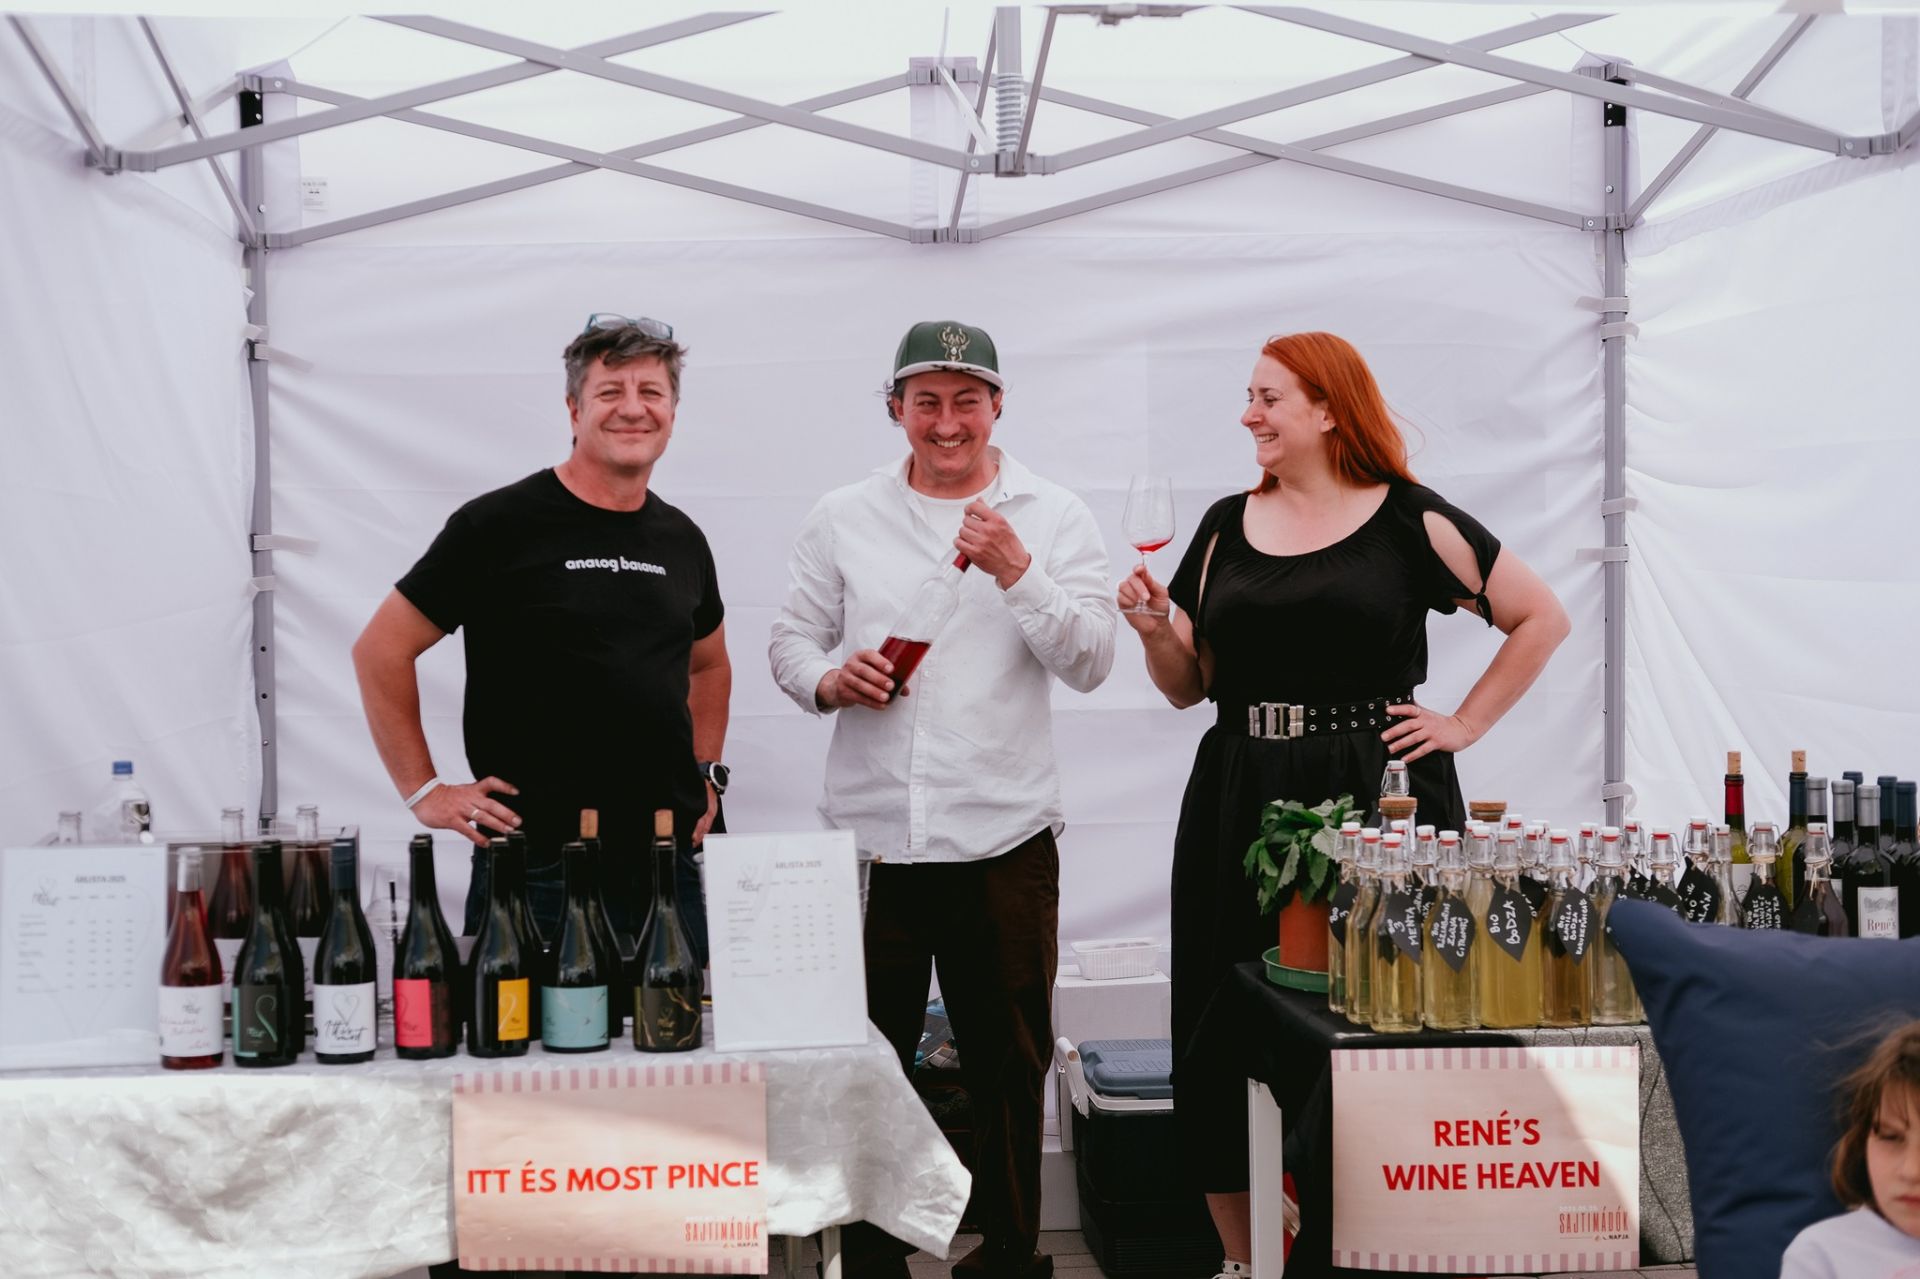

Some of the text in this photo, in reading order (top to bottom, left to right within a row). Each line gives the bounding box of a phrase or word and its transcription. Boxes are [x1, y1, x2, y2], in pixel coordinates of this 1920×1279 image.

[565, 558, 619, 573] analog
[1502, 900, 1521, 945] BODZA
[1557, 914, 1565, 929] BIO
[1562, 904, 1572, 942] KAMILLA
[1698, 891, 1712, 923] ALÁN
[1404, 906, 1420, 946] MENTA
[1489, 913, 1501, 934] BIO
[1569, 911, 1578, 941] BODZA
[1433, 1109, 1542, 1148] RENÉ'S
[466, 1159, 760, 1194] ITT ÉS MOST PINCE
[1381, 1160, 1601, 1192] WINE HEAVEN
